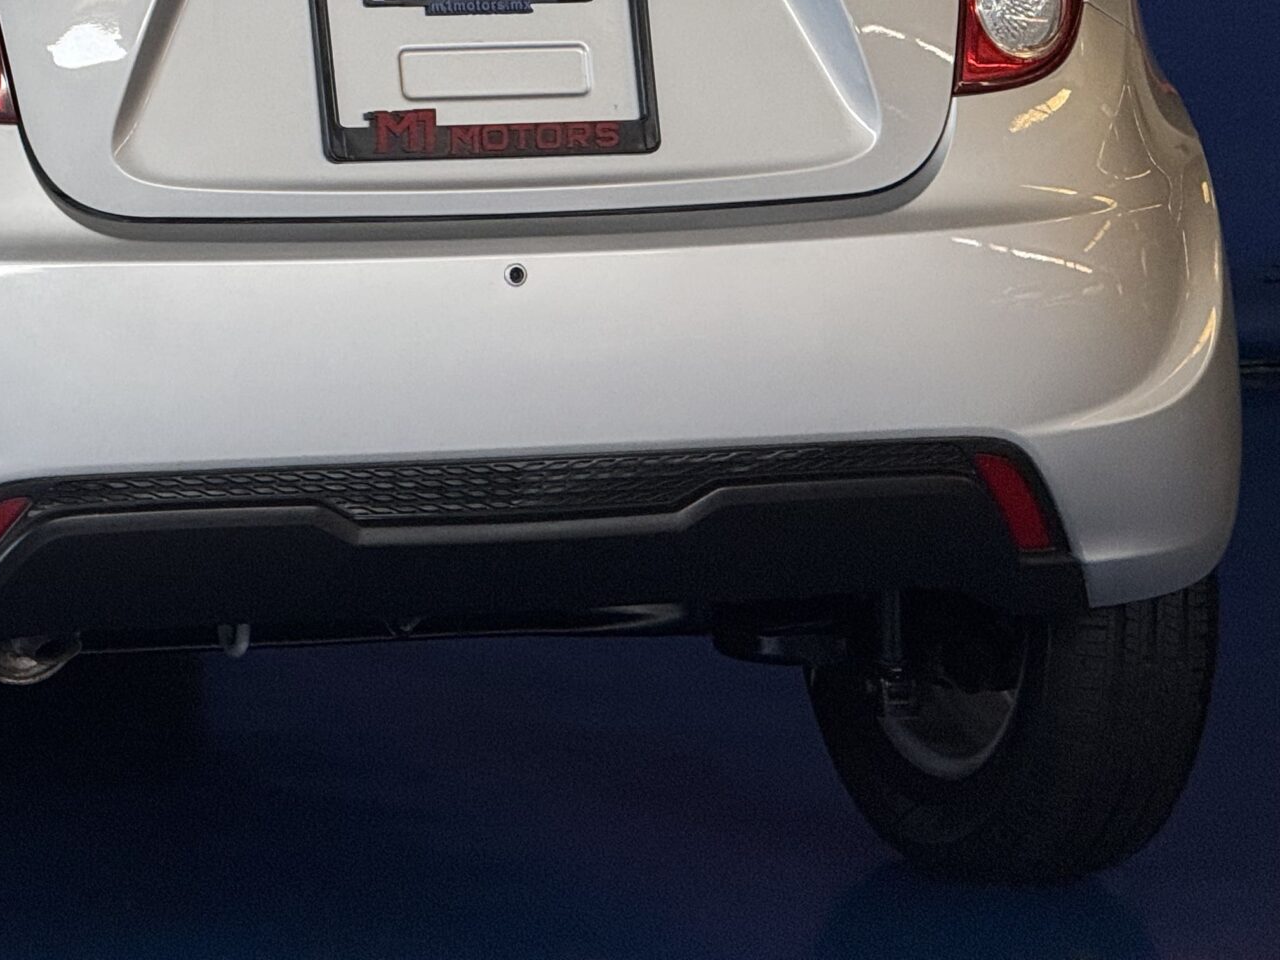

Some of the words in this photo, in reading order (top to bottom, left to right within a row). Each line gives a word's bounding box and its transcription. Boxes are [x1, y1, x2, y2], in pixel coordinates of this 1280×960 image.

[431, 0, 531, 13] m1motors.mx
[373, 108, 437, 155] M1
[448, 121, 621, 155] MOTORS
